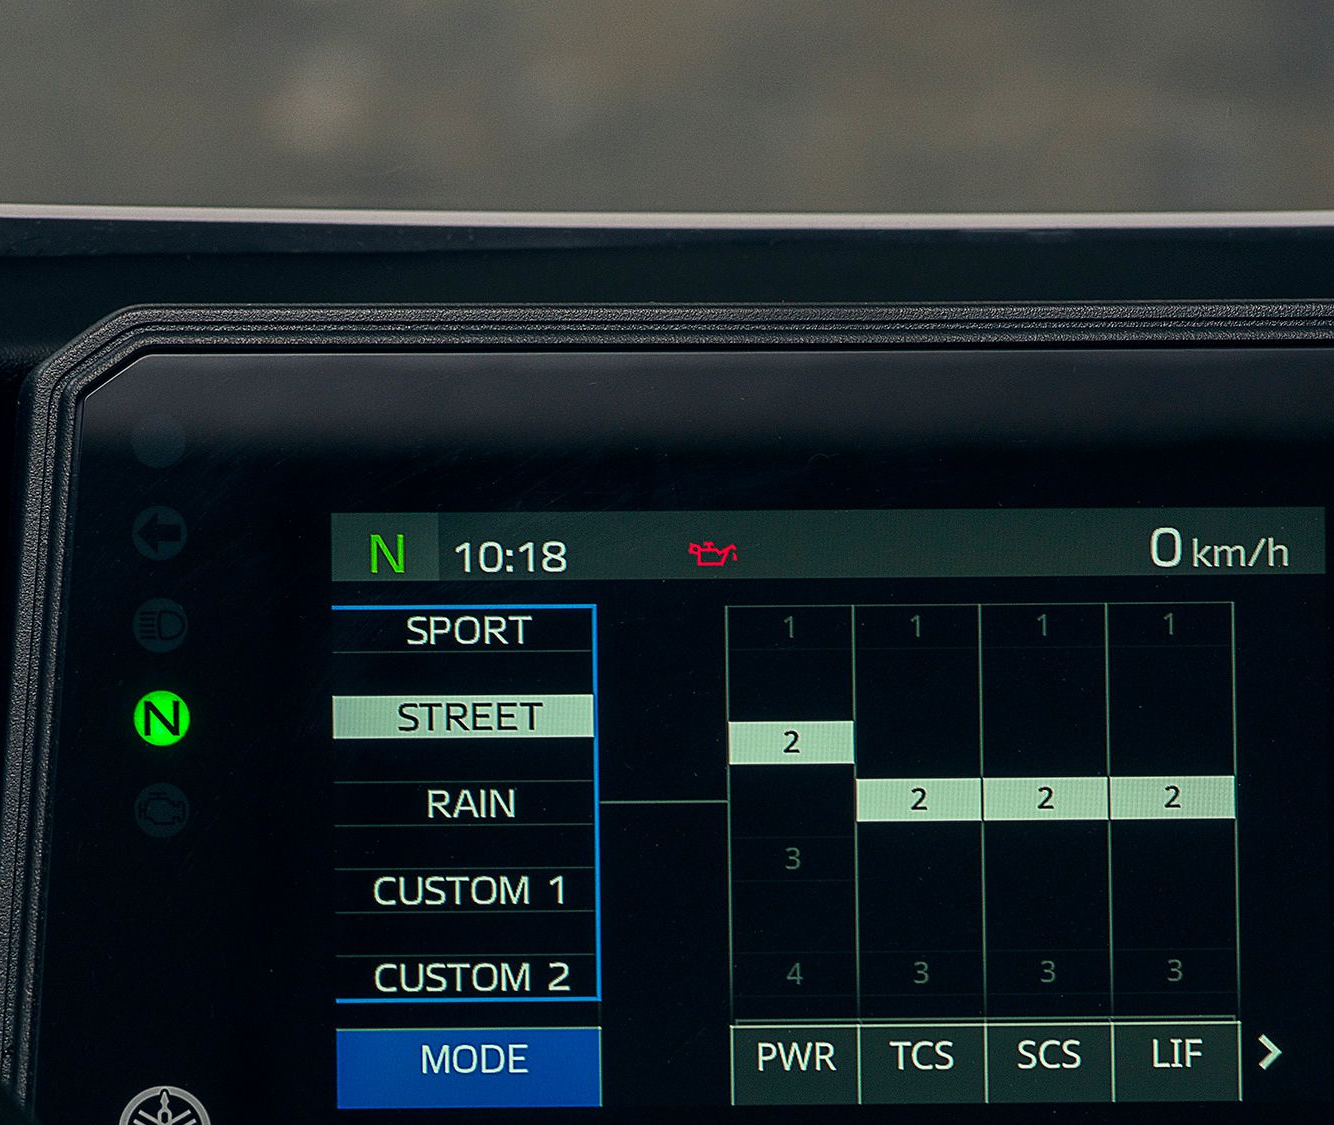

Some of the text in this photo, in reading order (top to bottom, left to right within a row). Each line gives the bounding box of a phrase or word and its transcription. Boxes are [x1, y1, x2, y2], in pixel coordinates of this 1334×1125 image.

[370, 533, 405, 574] N
[455, 540, 567, 573] 10:18
[1150, 527, 1289, 568] 0 km/h
[407, 615, 533, 645] SPORT
[783, 615, 794, 639] 1
[910, 614, 921, 638] 1
[1037, 613, 1047, 637] 1
[1163, 612, 1174, 636] 1
[144, 699, 180, 736] N
[397, 702, 544, 732] STREET
[783, 730, 800, 754] 2
[427, 788, 516, 819] RAIN
[910, 787, 928, 811] 2
[1037, 786, 1055, 810] 2
[1164, 785, 1181, 809] 2
[785, 847, 801, 870] 3
[373, 875, 564, 906] CUSTOM 1
[374, 961, 571, 993] CUSTOM 2
[786, 962, 804, 985] 4
[913, 961, 929, 984] 3
[1040, 960, 1056, 983] 3
[1167, 959, 1183, 982] 3
[420, 1042, 529, 1076] MODE
[757, 1041, 837, 1072] PWR
[889, 1040, 954, 1071] TCS
[1017, 1039, 1082, 1069] SCS
[1152, 1038, 1203, 1068] LIF
